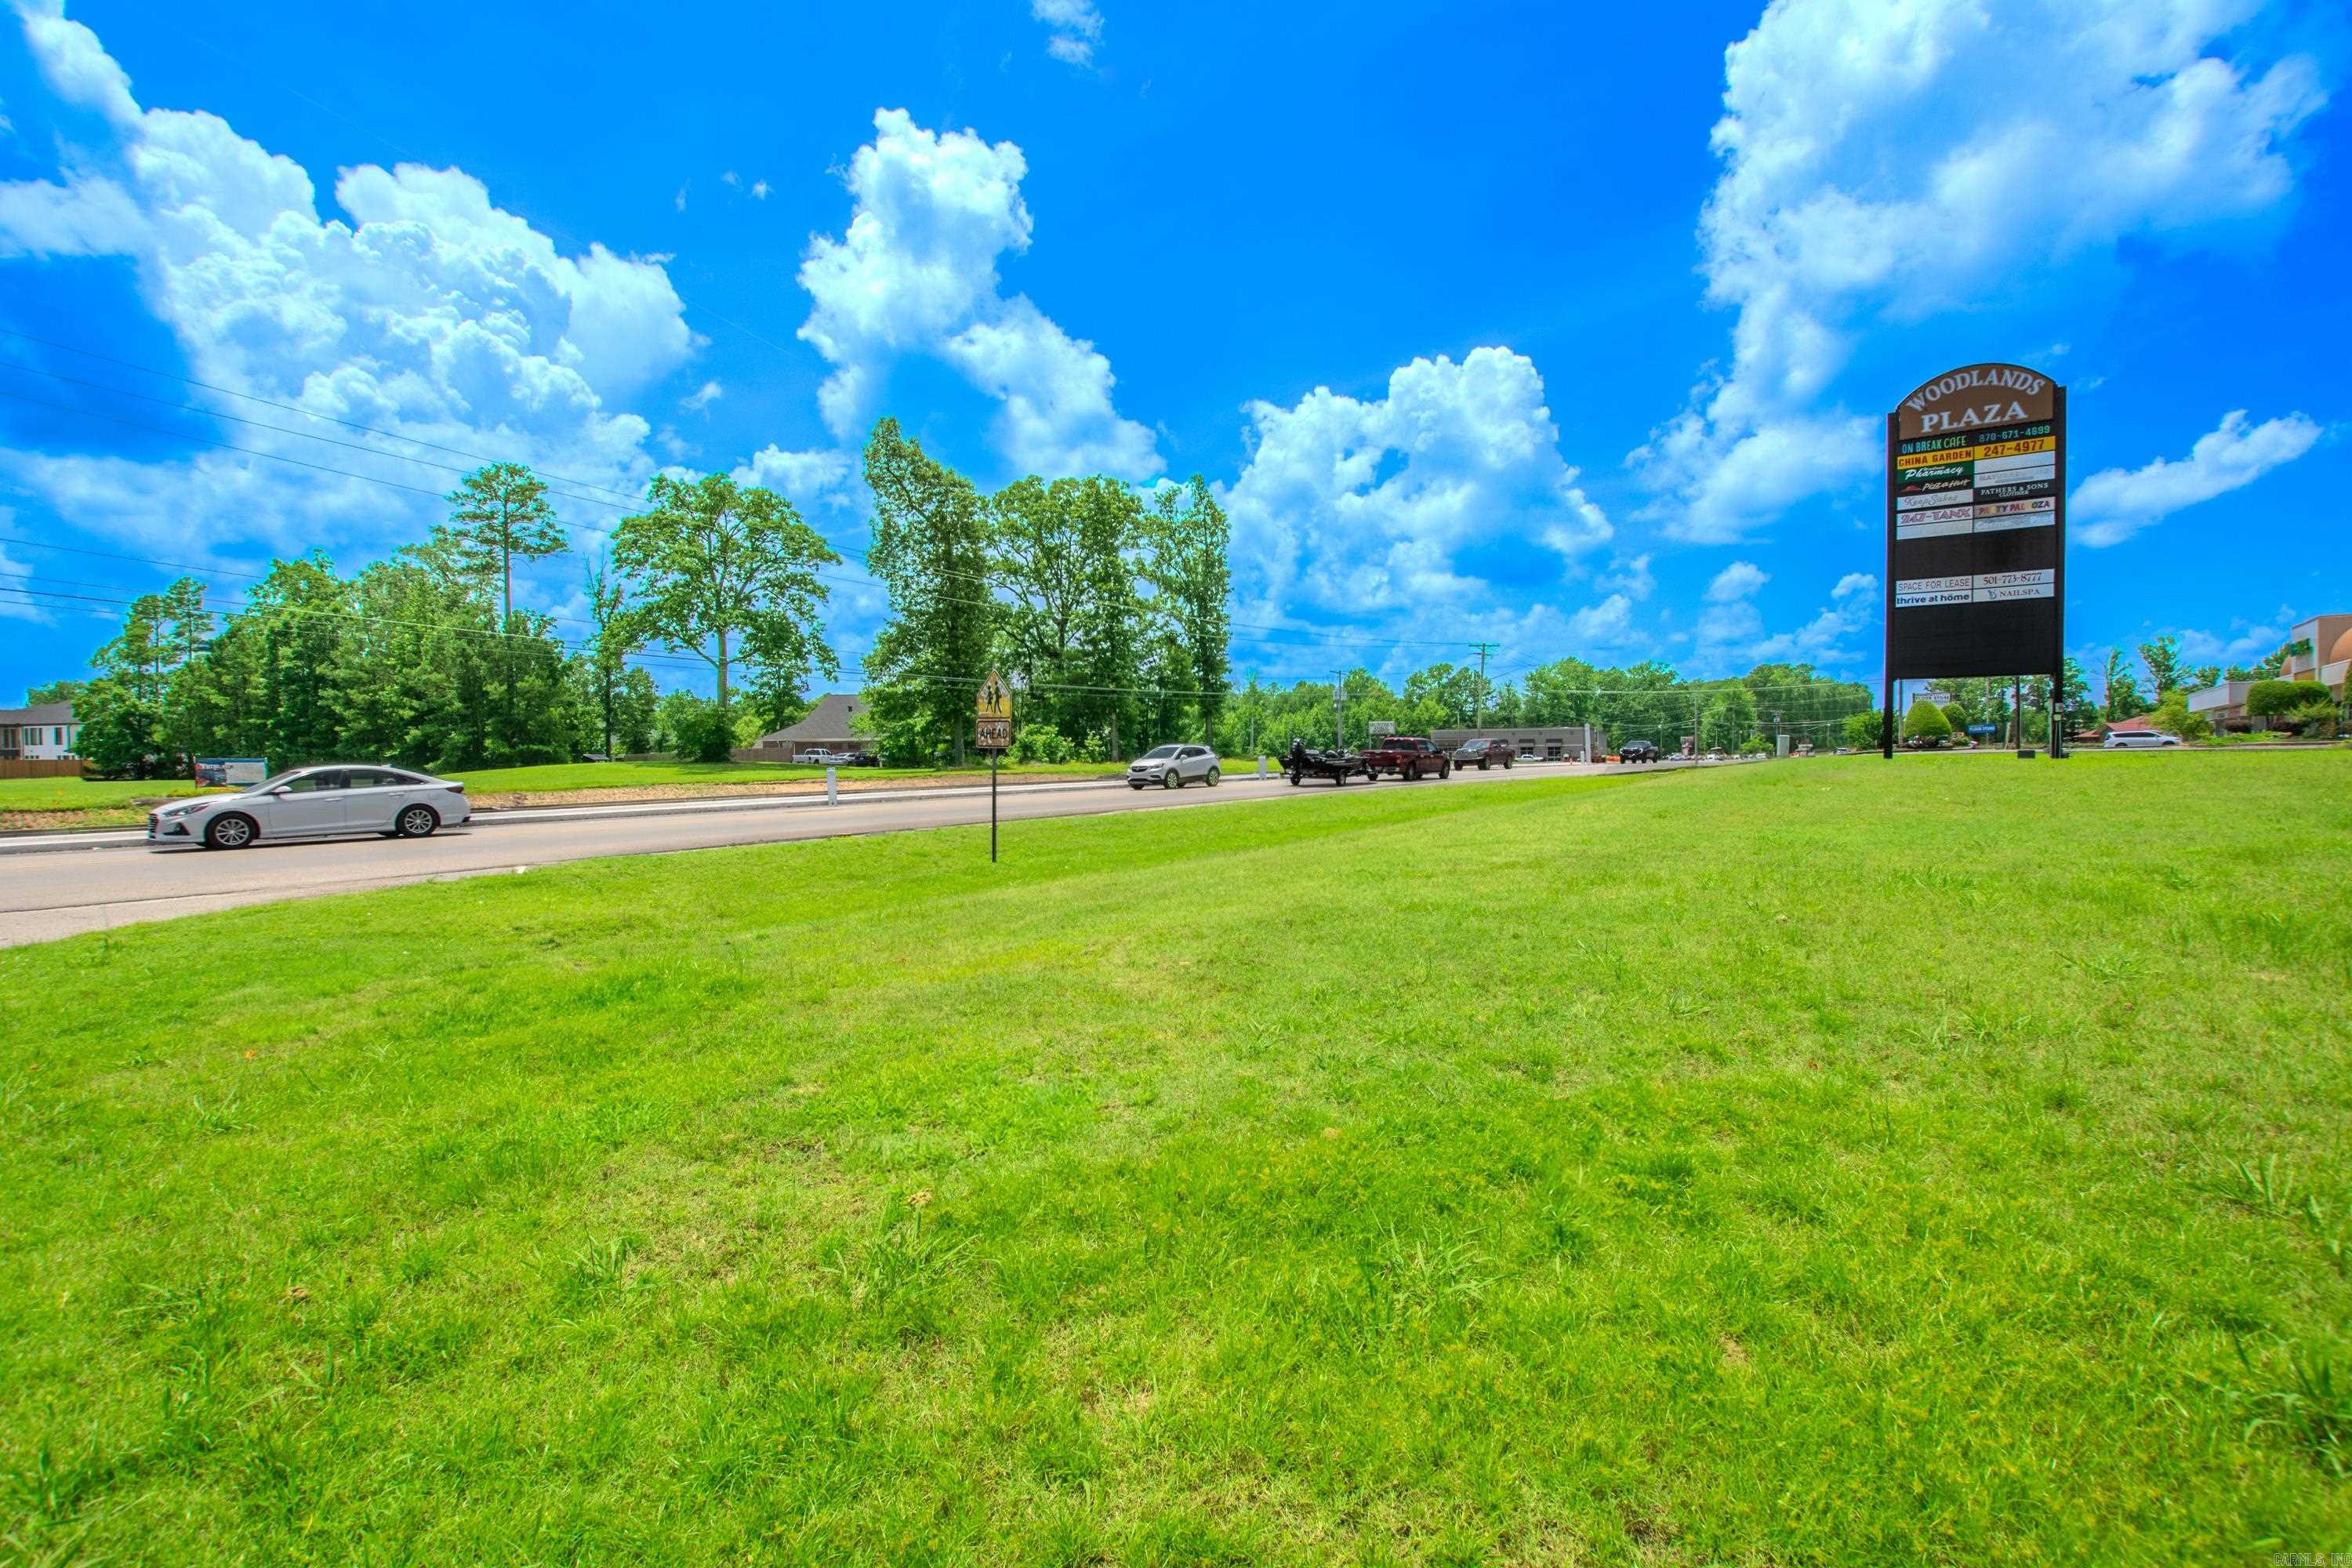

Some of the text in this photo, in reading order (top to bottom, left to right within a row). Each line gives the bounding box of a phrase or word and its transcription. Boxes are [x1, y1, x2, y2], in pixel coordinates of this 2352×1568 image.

[1906, 368, 2046, 412] WOODLANDS
[1922, 401, 2028, 433] PLAZA
[1902, 435, 1967, 454] ON BREAK CAFE
[1984, 439, 2045, 457] 247-4977
[1899, 450, 1972, 466] CHINA GARDEN
[1905, 466, 1964, 480] Pharmacy
[1980, 486, 2016, 495] FATHERS
[1898, 582, 1923, 591] SPACE
[1944, 579, 1970, 588] LEASE
[1897, 596, 1926, 604] thrive
[979, 728, 1007, 739] AHEAD
